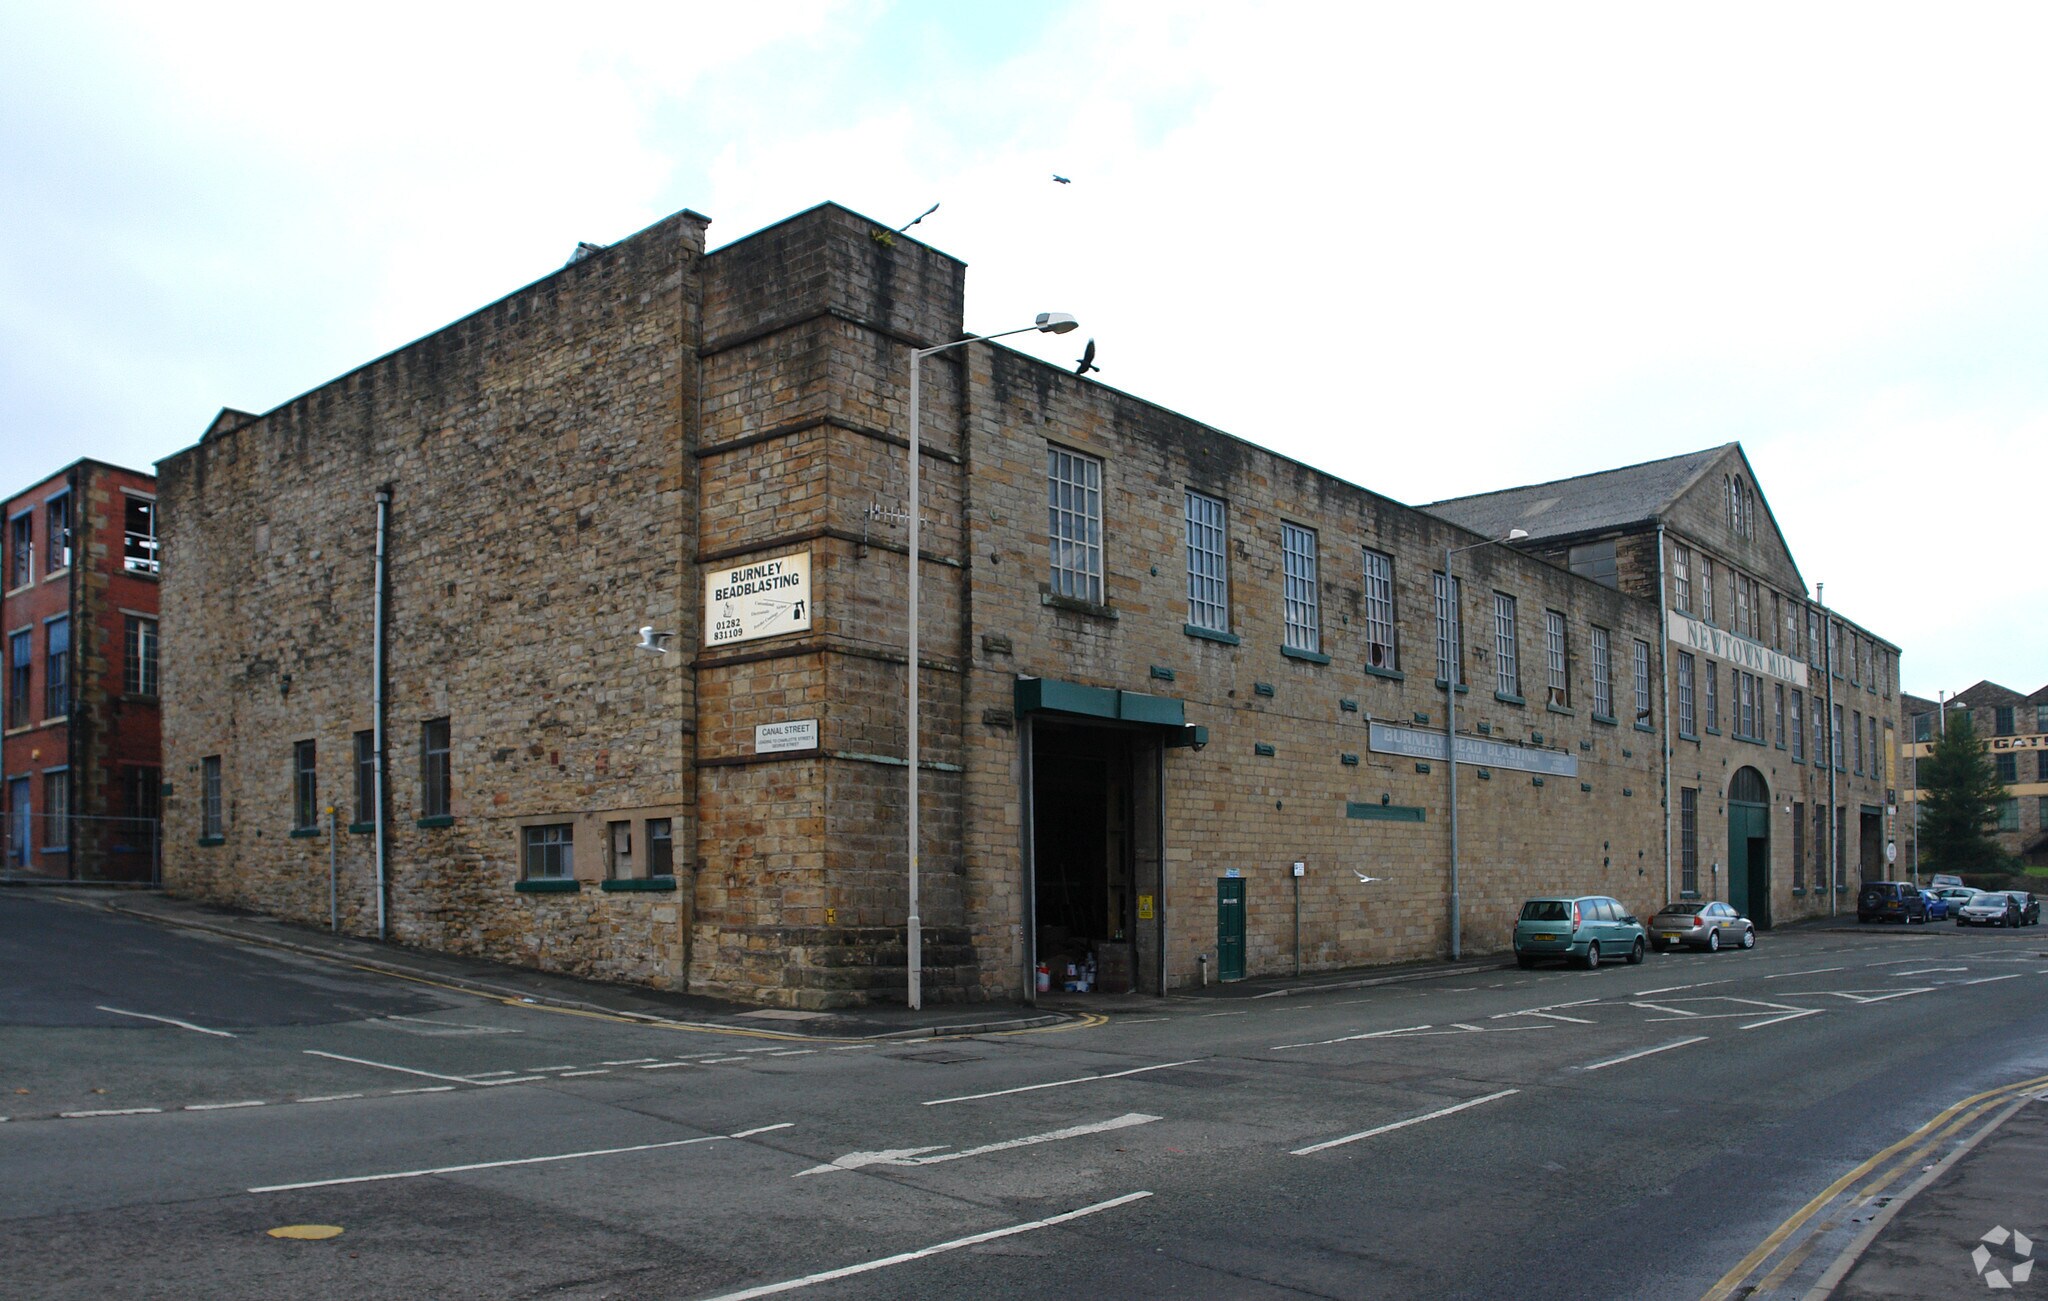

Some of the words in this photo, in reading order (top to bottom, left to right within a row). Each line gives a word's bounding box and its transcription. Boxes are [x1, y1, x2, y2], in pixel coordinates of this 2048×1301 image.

[731, 562, 782, 583] BURNLEY
[715, 573, 799, 601] BEADBLASTING
[714, 628, 743, 640] 831109
[716, 618, 740, 630] 01282
[1686, 620, 1764, 671] NEWTOWN
[1767, 651, 1797, 683] MILL
[762, 727, 783, 736] CANAL
[784, 724, 810, 734] STREET
[1384, 728, 1444, 748] BURNLEY
[1487, 743, 1538, 764] BLASTING
